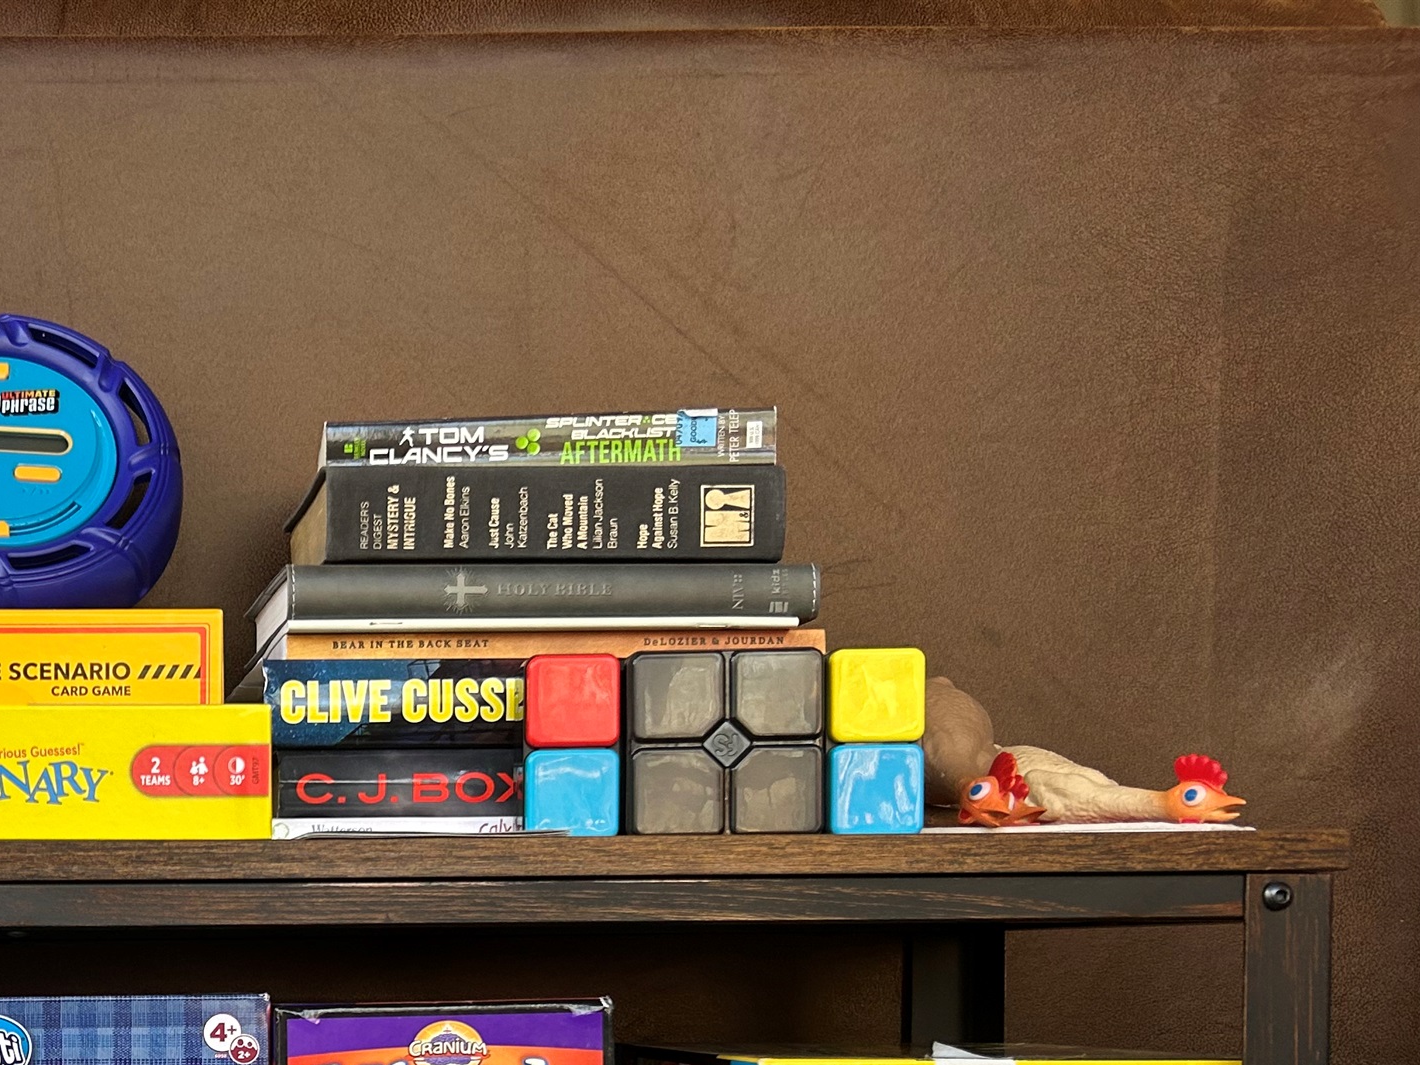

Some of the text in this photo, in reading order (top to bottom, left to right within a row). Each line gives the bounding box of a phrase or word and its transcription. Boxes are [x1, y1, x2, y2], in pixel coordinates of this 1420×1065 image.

[1, 389, 56, 401] ULTIMATE
[418, 427, 484, 445] TOM
[370, 445, 509, 466] CLANCY'S
[560, 440, 680, 466] AFTERMATH
[360, 501, 370, 550] READER'S
[386, 484, 400, 550] MYSTERY &
[403, 497, 416, 550] INTRIGUE
[489, 497, 500, 549] Just Cause
[517, 486, 529, 549] Katzenbach
[373, 513, 383, 550] DIGEST
[504, 522, 515, 549] John
[497, 583, 613, 597] HOLY BIBLE
[332, 639, 490, 649] BEAR IN THE BACK SEAT
[8, 663, 131, 681] SCENARIO
[51, 685, 131, 697] CARD GAME
[280, 678, 392, 724] CLIVE
[30, 744, 81, 759] Guesses!
[150, 757, 161, 773] 2
[140, 774, 171, 786] TEAMS
[295, 772, 518, 804] C. J. BOX
